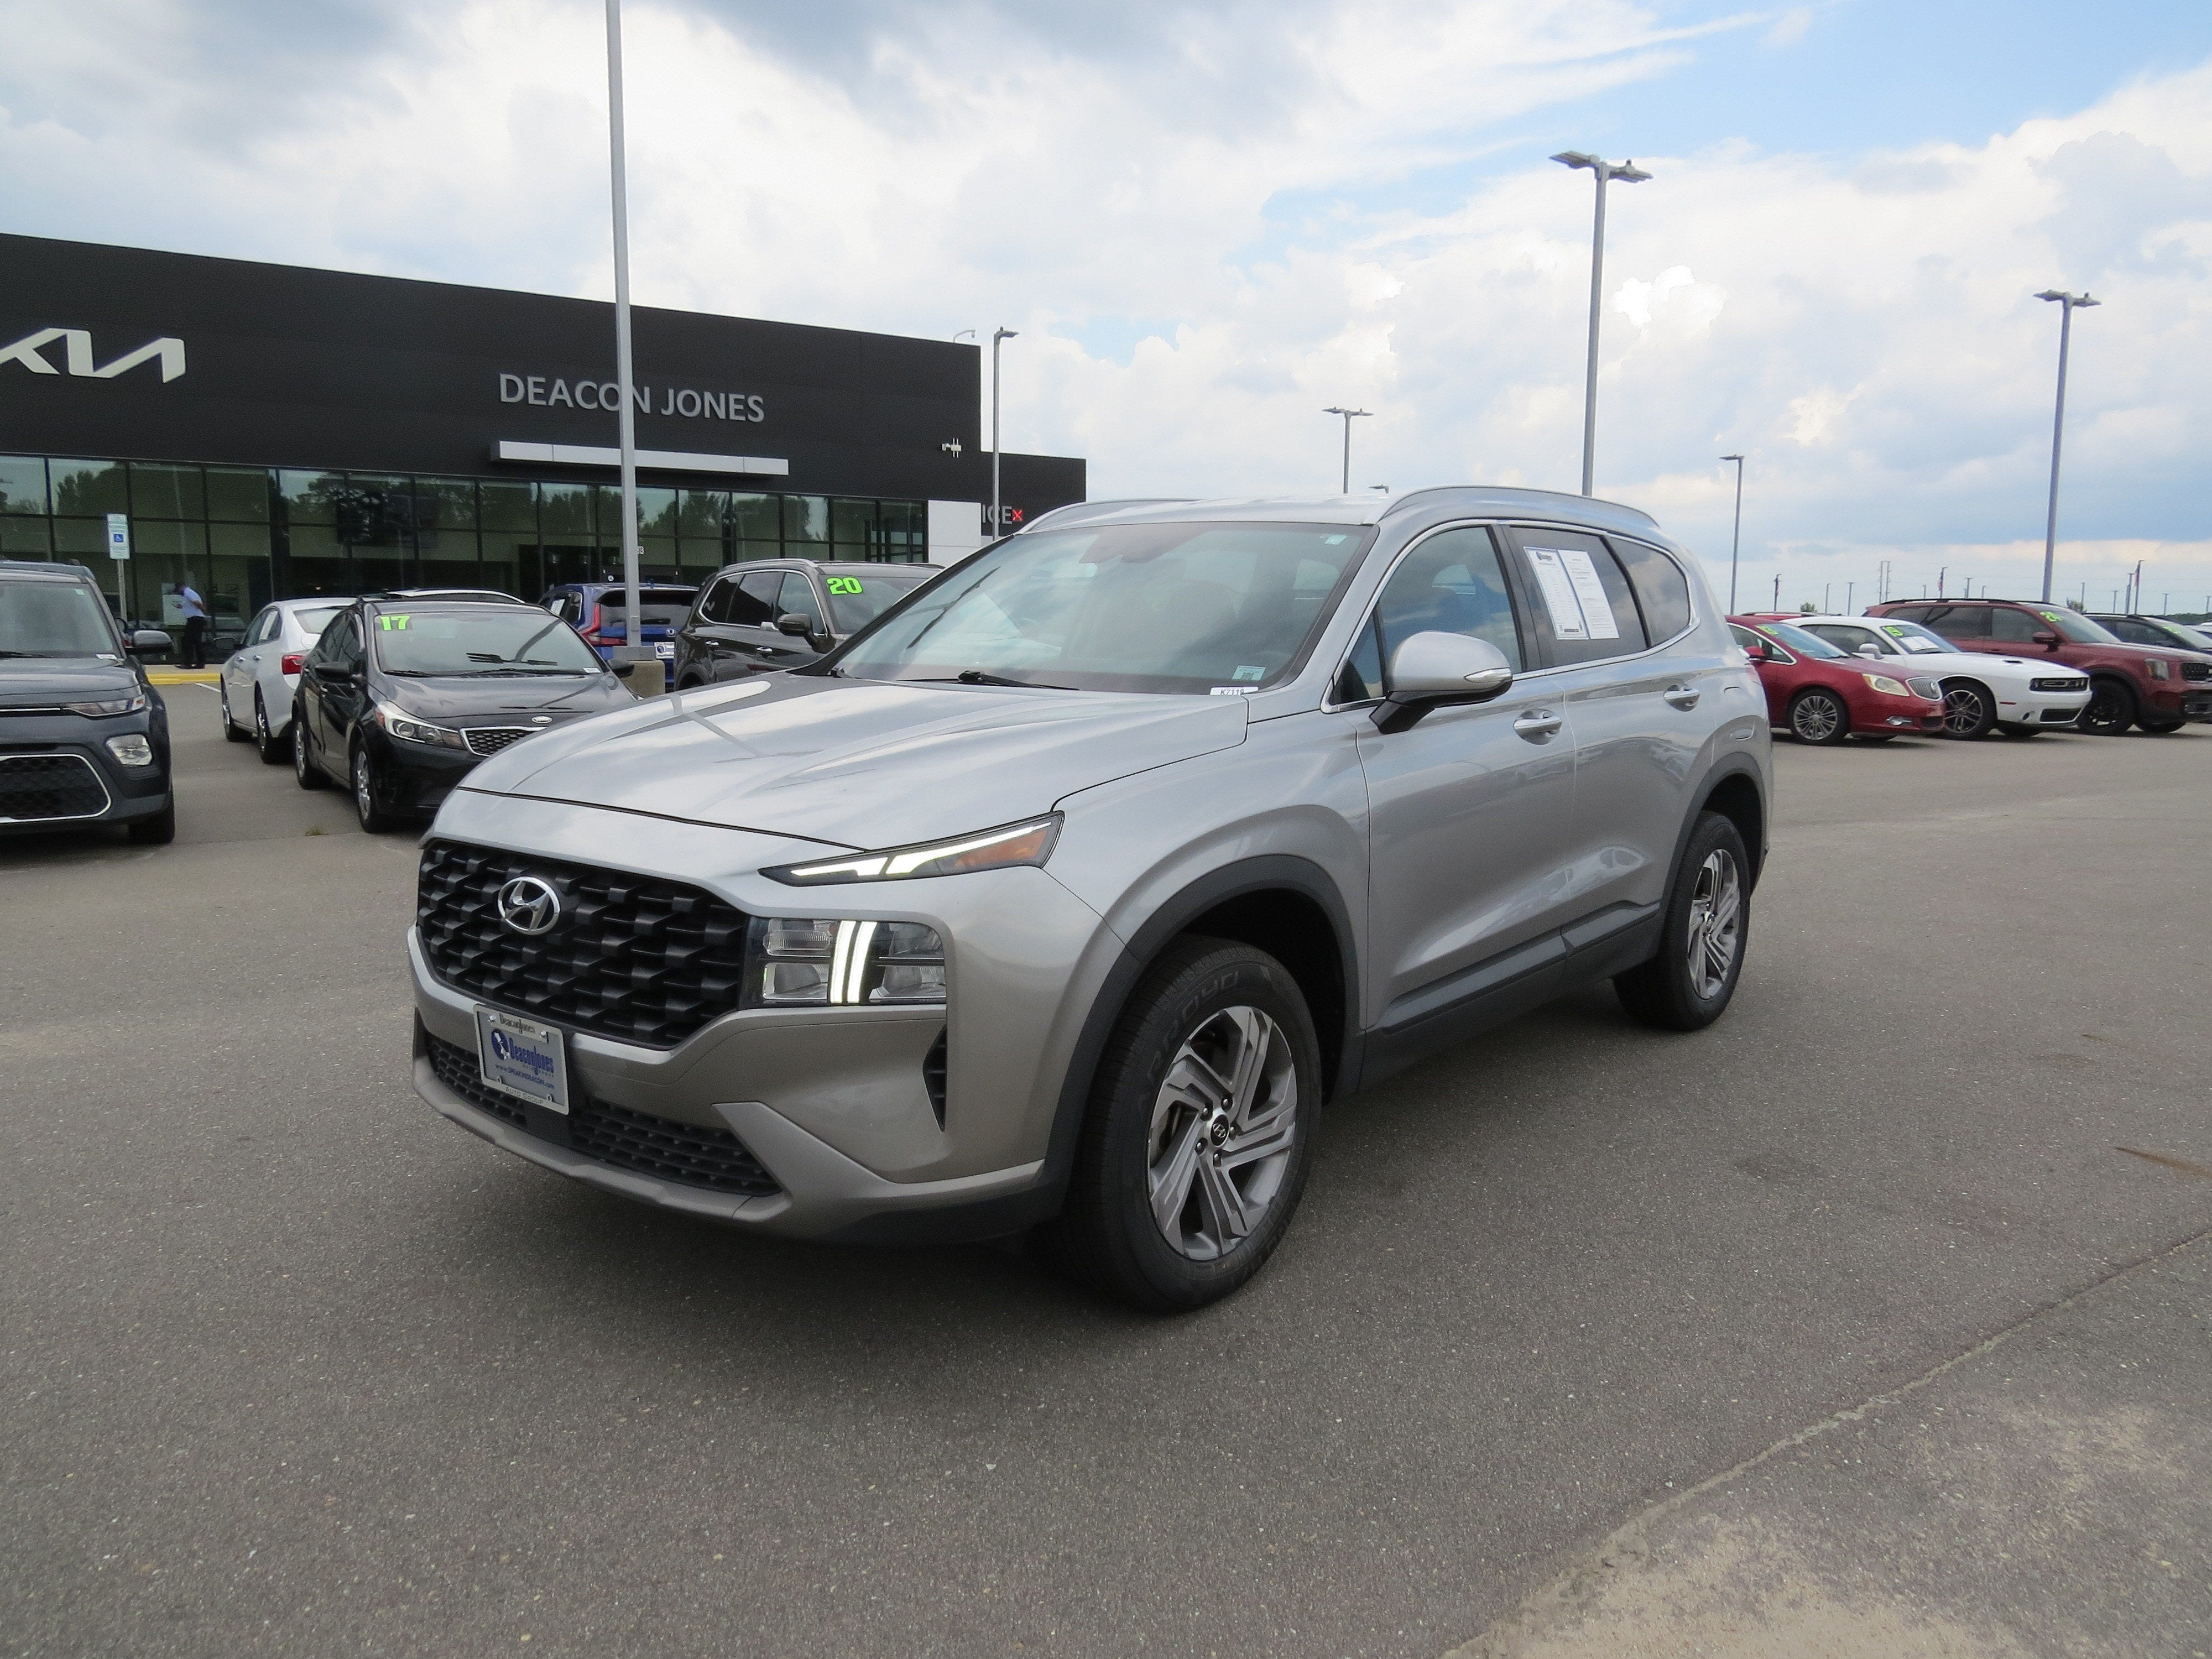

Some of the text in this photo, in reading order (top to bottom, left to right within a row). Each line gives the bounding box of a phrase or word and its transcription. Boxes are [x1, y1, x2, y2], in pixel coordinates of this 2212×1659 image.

[499, 373, 765, 422] DEACON JONES
[827, 577, 863, 594] 20
[380, 615, 410, 630] 17
